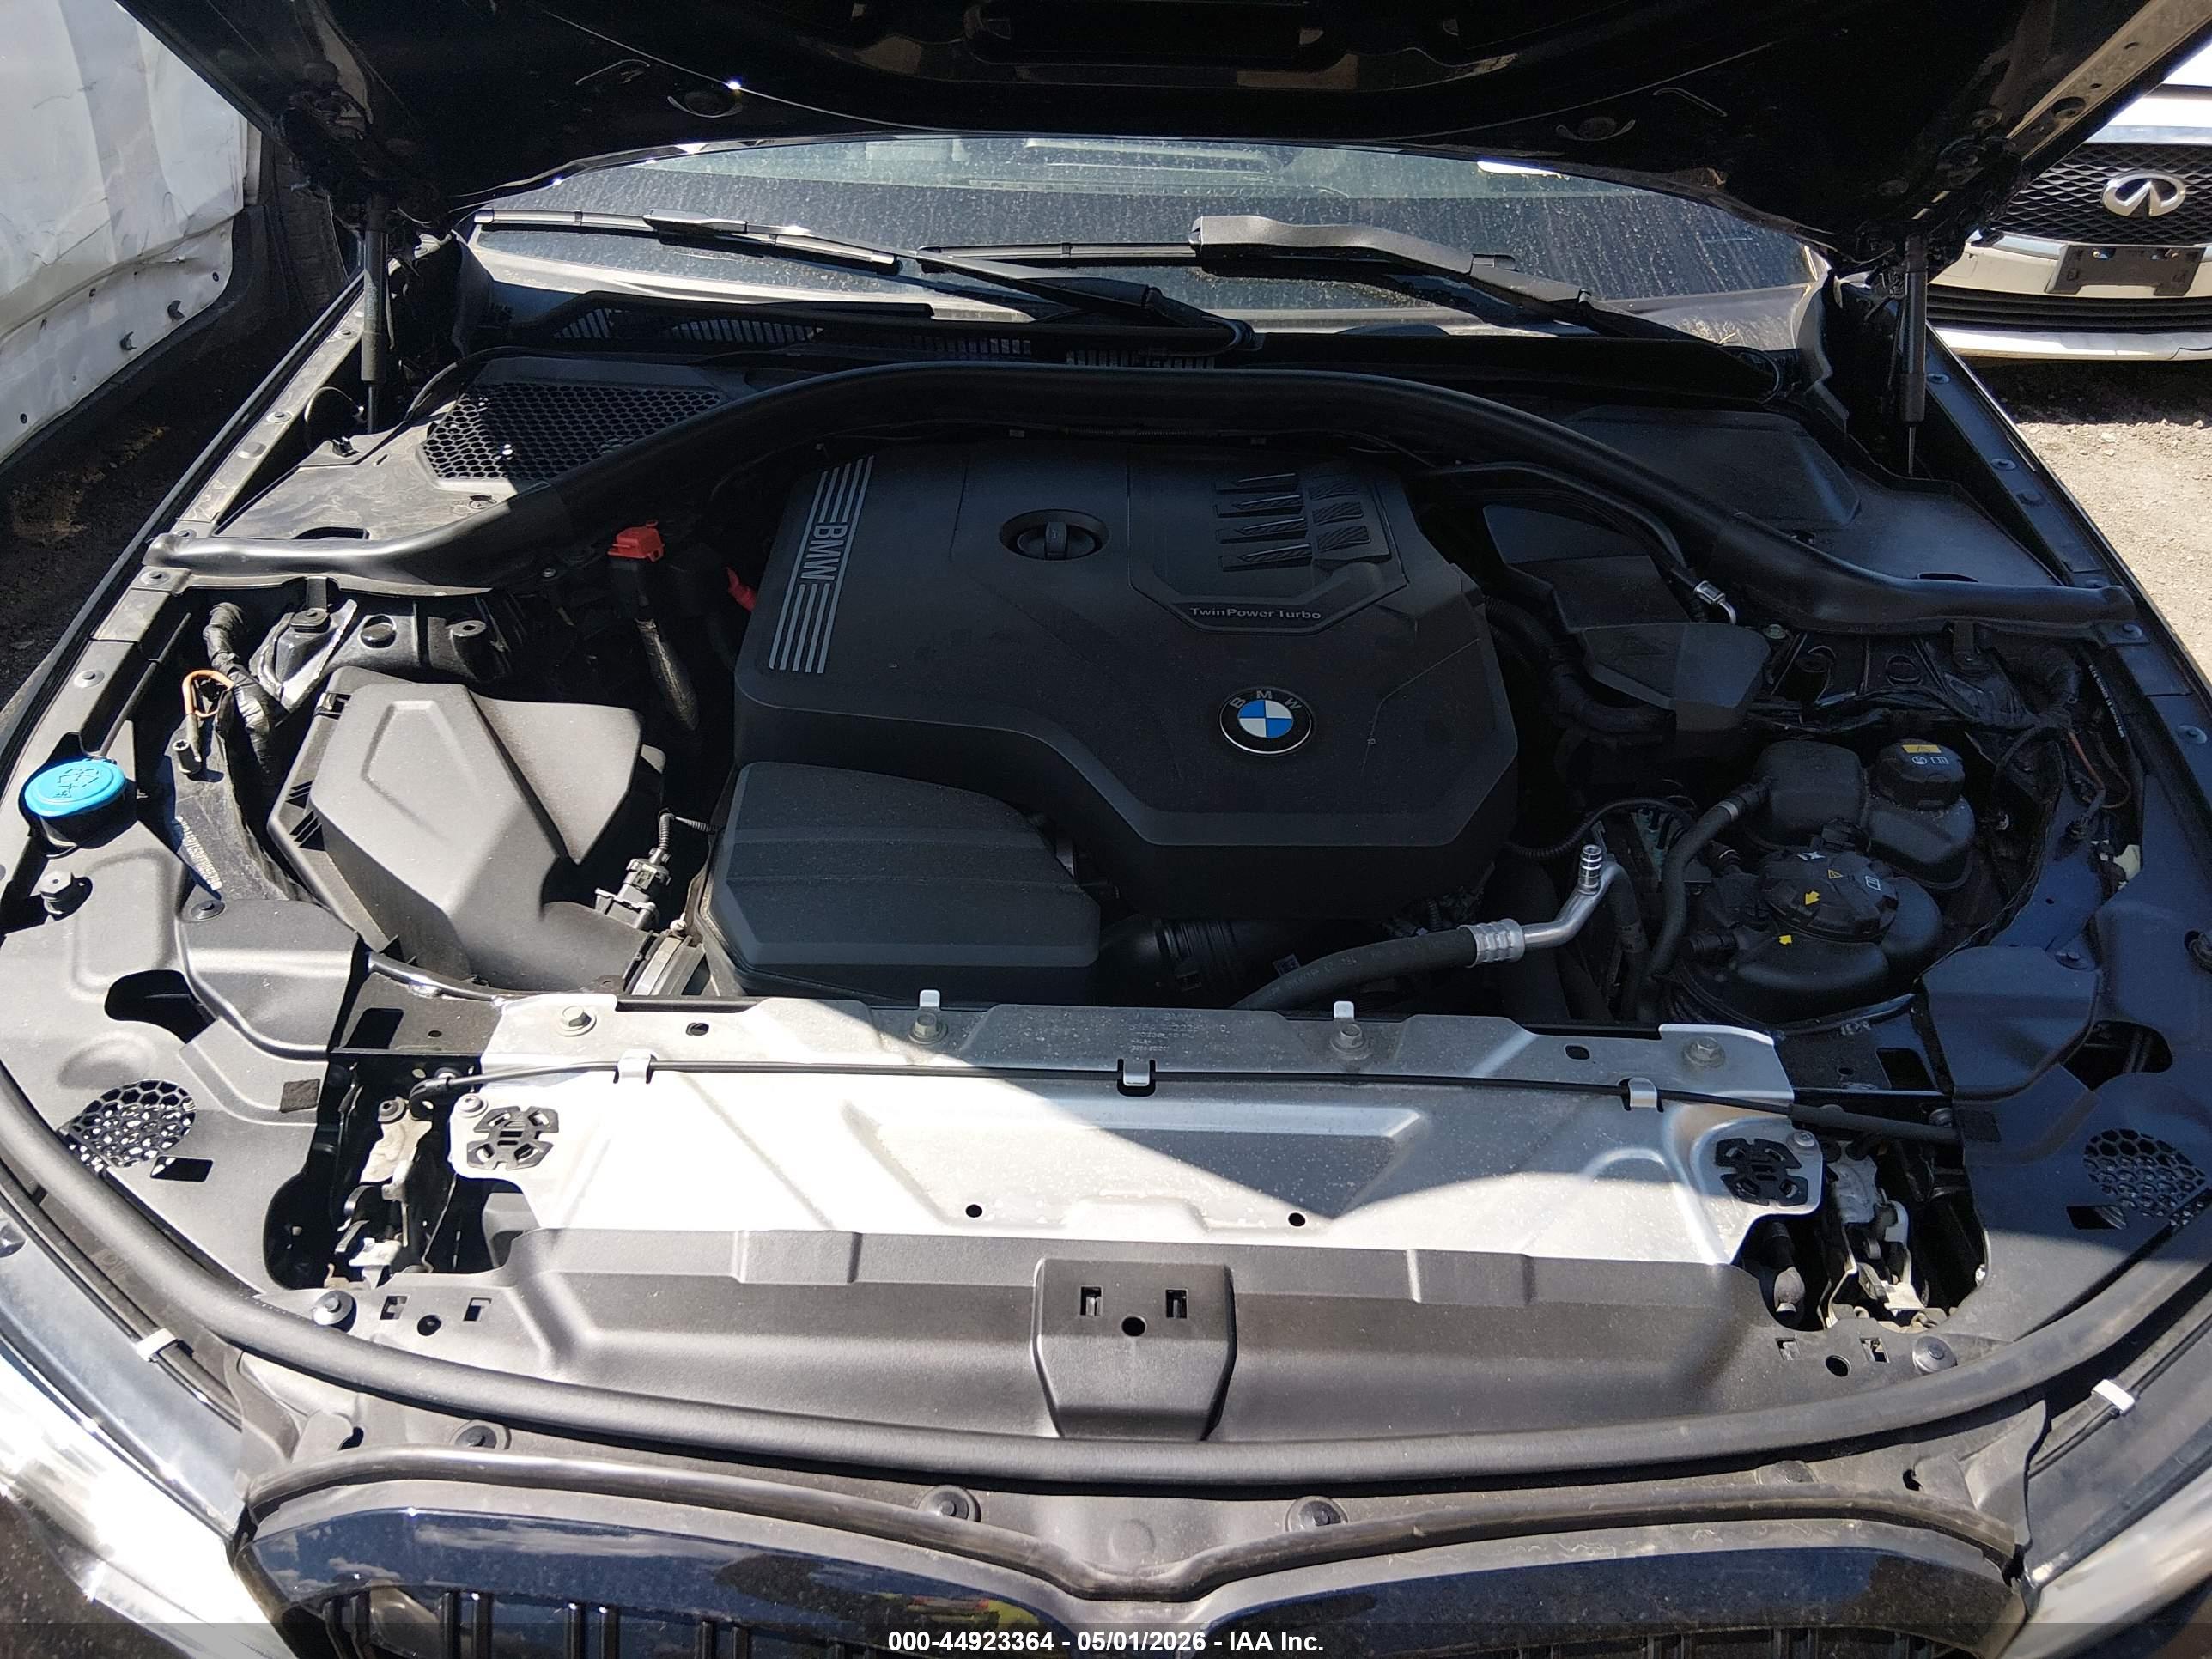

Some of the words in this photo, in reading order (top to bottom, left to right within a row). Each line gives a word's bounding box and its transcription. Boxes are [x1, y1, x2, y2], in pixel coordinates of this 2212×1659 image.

[800, 524, 849, 580] BMW
[1276, 610, 1322, 619] Turbo
[1230, 690, 1302, 709] BMW
